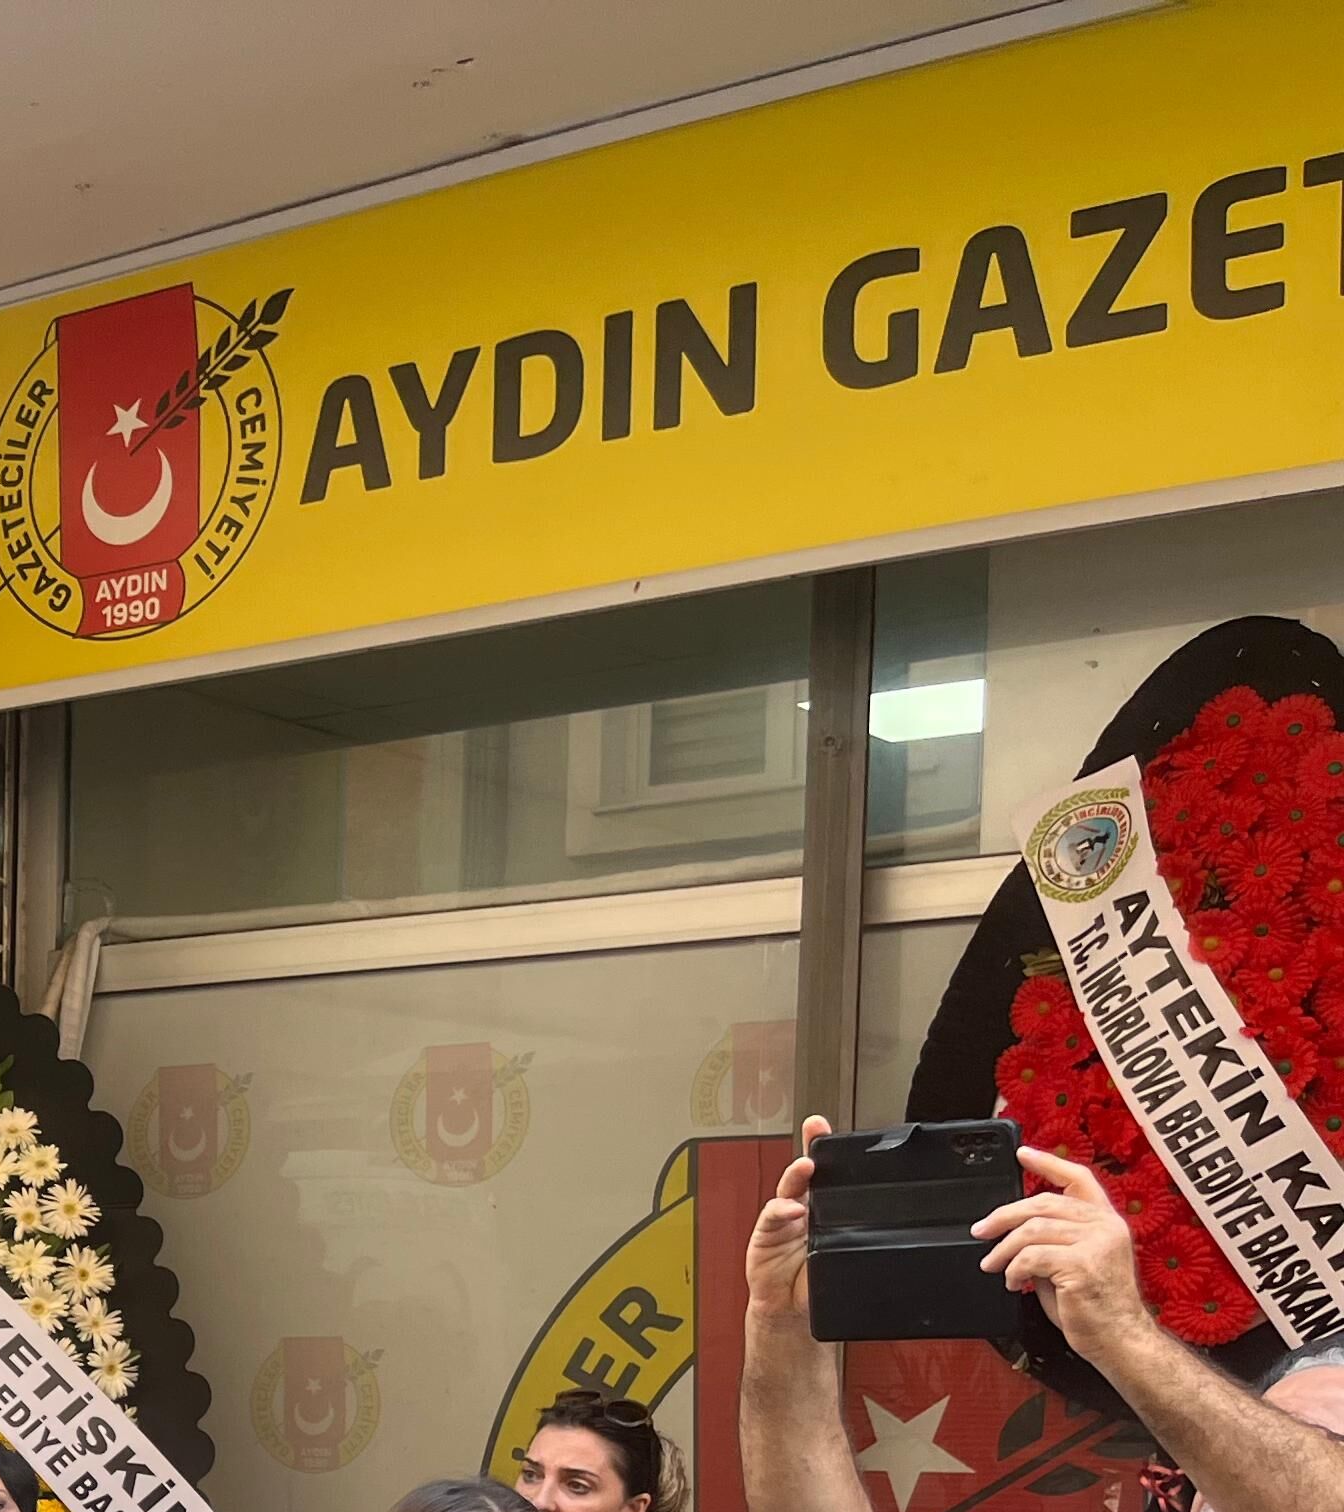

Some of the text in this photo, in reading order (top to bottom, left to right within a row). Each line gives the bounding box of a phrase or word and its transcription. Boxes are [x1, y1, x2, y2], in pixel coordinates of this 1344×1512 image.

[299, 281, 758, 506] AYDIN
[0, 378, 73, 613] GAZETECİLER
[194, 386, 267, 581] CEMİYETİ
[95, 570, 168, 602] AYDIN
[101, 597, 161, 627] 1990
[1067, 913, 1104, 977] T.C.
[1081, 953, 1186, 1115] İNCİRLİOVA
[1113, 888, 1344, 1273] AYTEKİN KA
[1153, 1098, 1275, 1240] BELEDİYE
